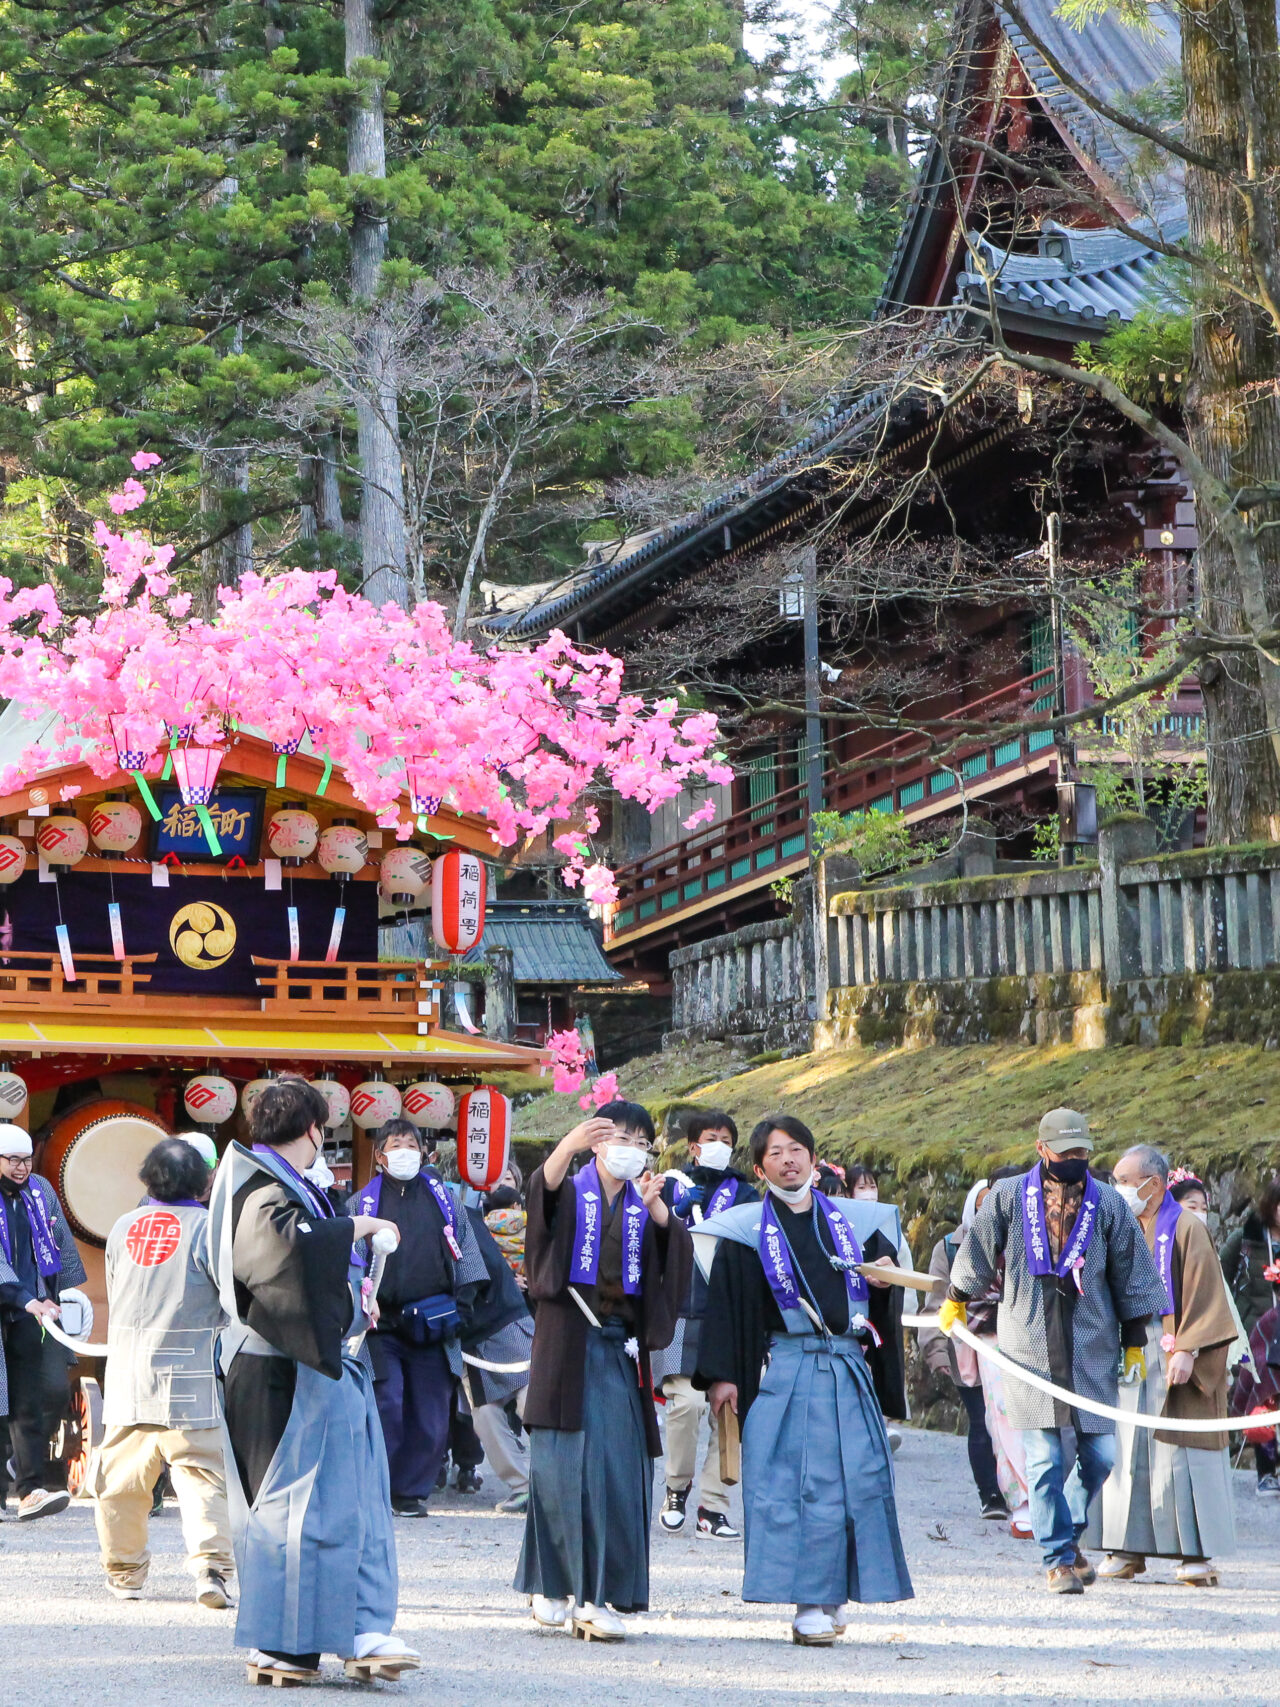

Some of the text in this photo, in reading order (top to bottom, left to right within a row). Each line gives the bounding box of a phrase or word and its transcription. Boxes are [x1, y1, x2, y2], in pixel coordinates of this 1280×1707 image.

[627, 1216, 641, 1284] 弥生祭当番町
